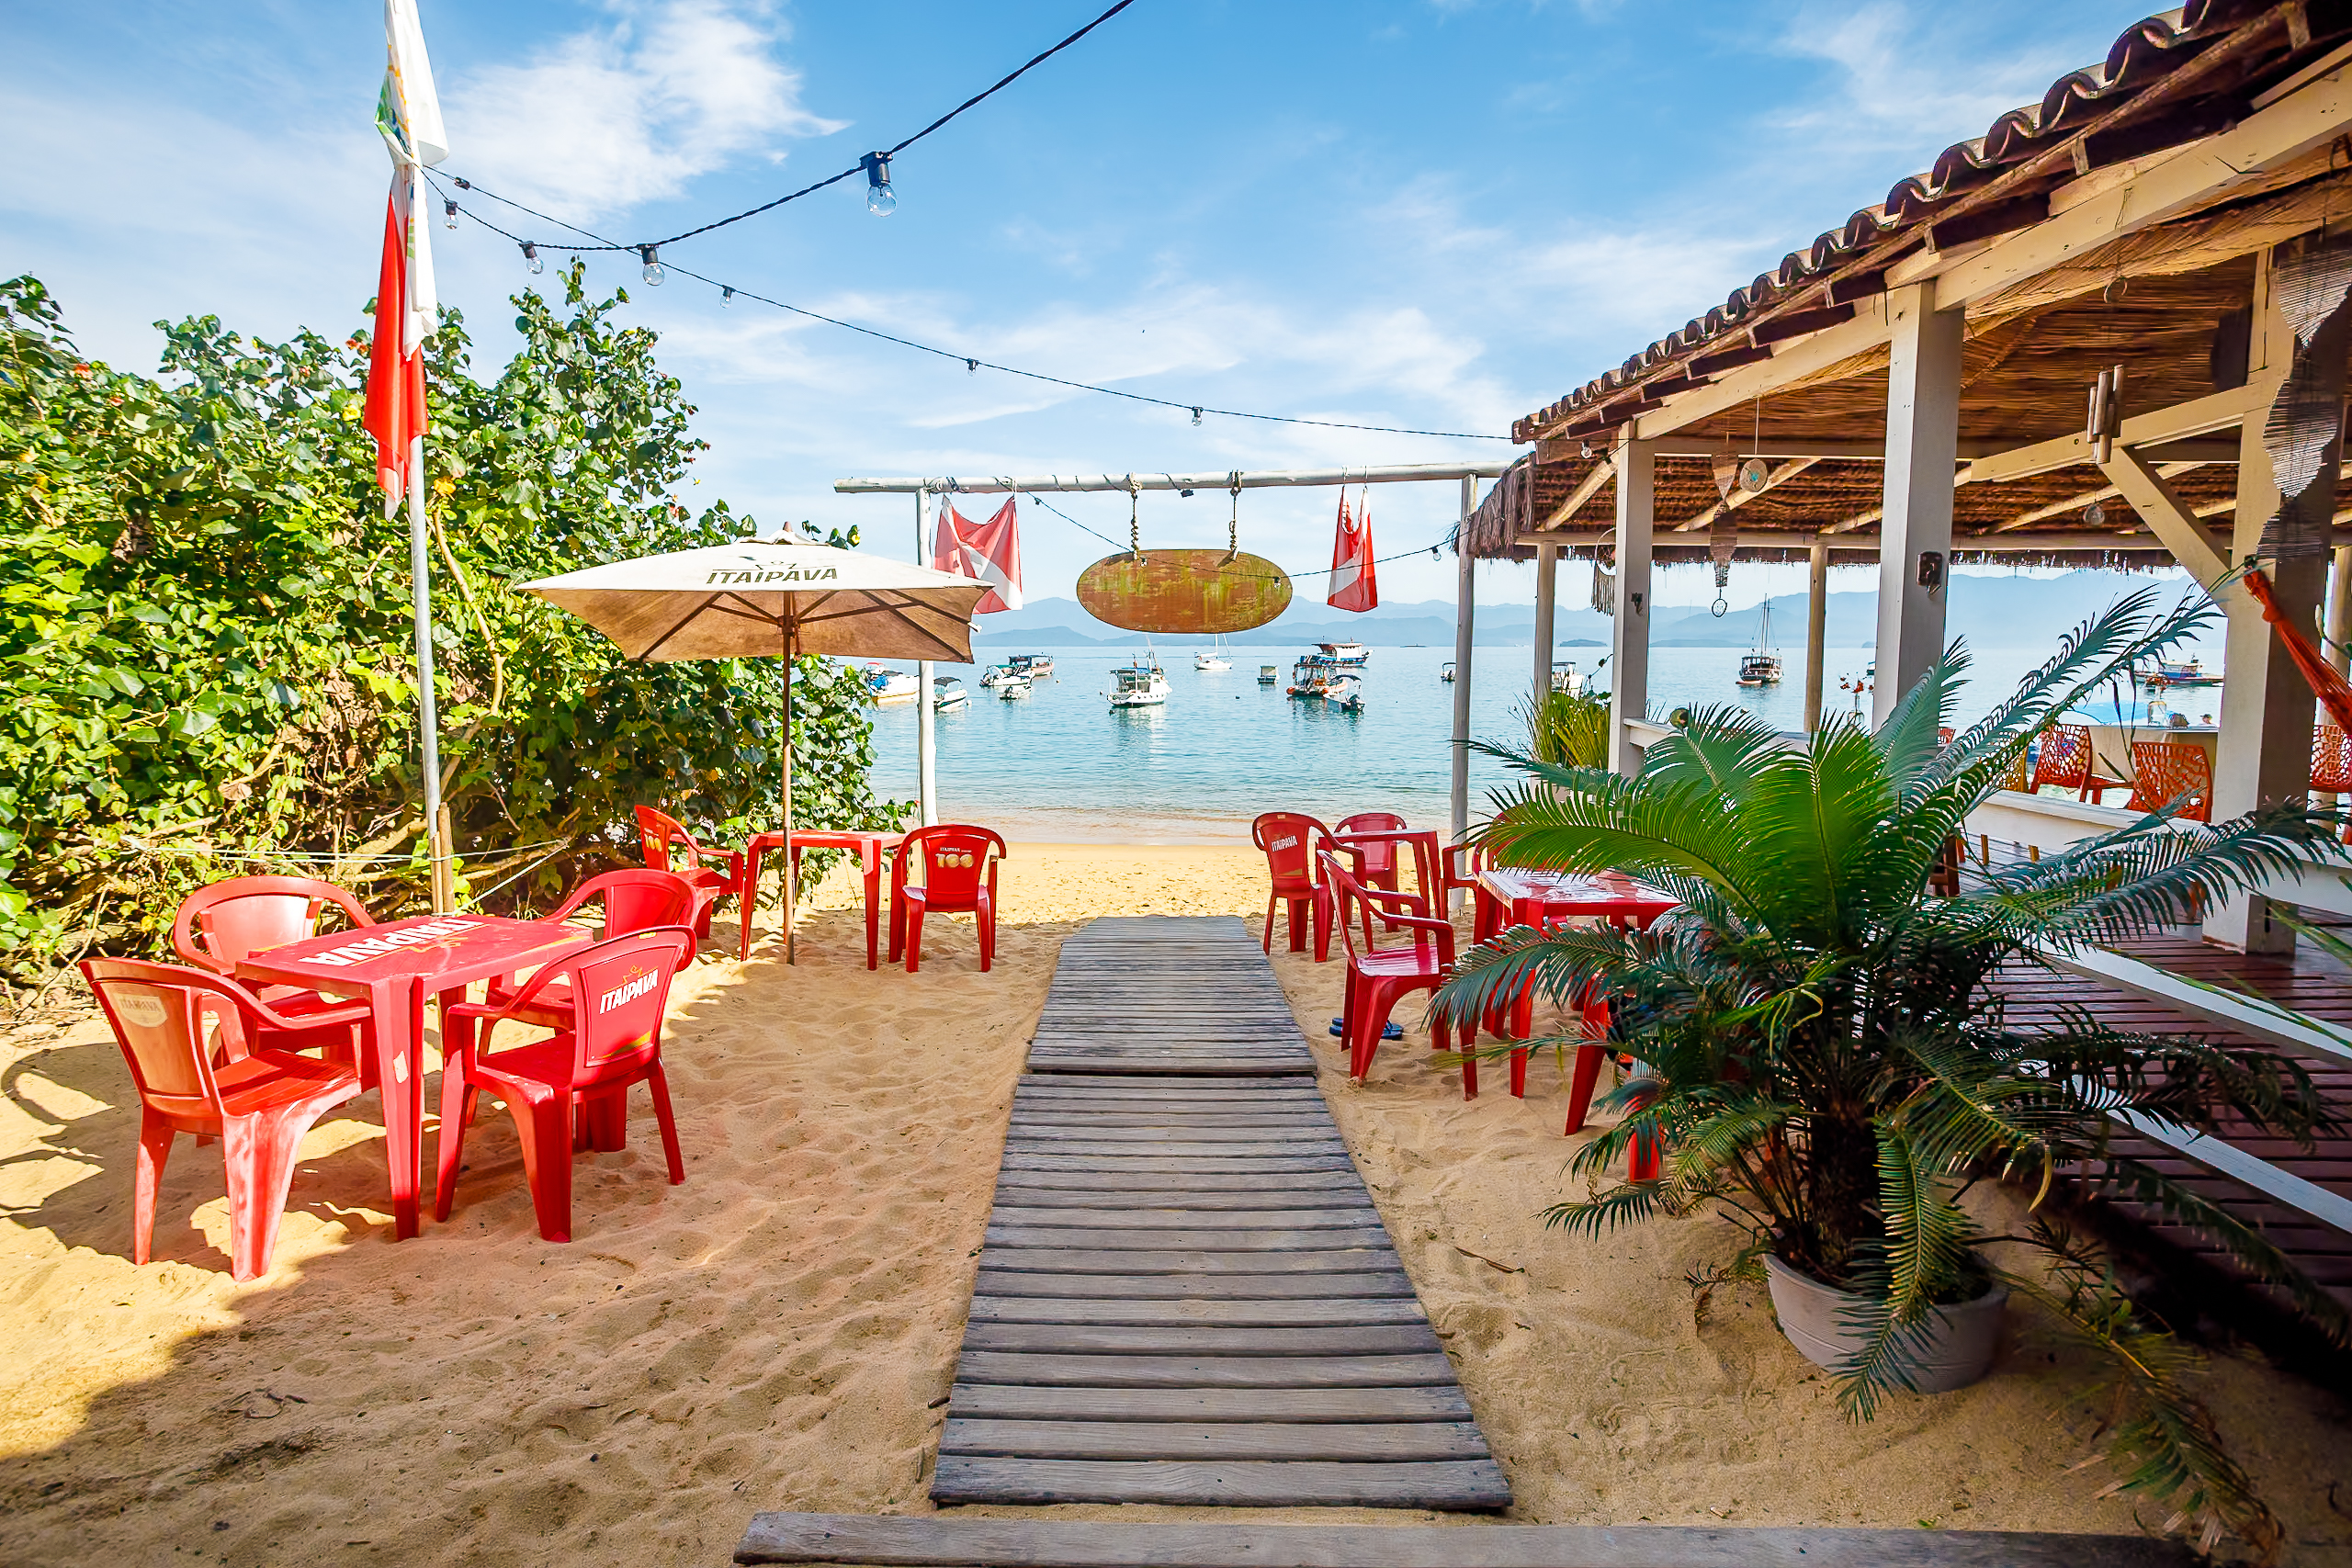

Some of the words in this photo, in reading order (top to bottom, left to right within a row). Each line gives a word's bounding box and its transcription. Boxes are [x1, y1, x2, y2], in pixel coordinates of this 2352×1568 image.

[706, 568, 838, 584] ITAIPAVA
[1272, 834, 1298, 852] ITAIPAVA
[935, 853, 974, 869] 100
[298, 919, 485, 967] ITAIPAVA
[599, 968, 659, 1015] ITAIPAVA
